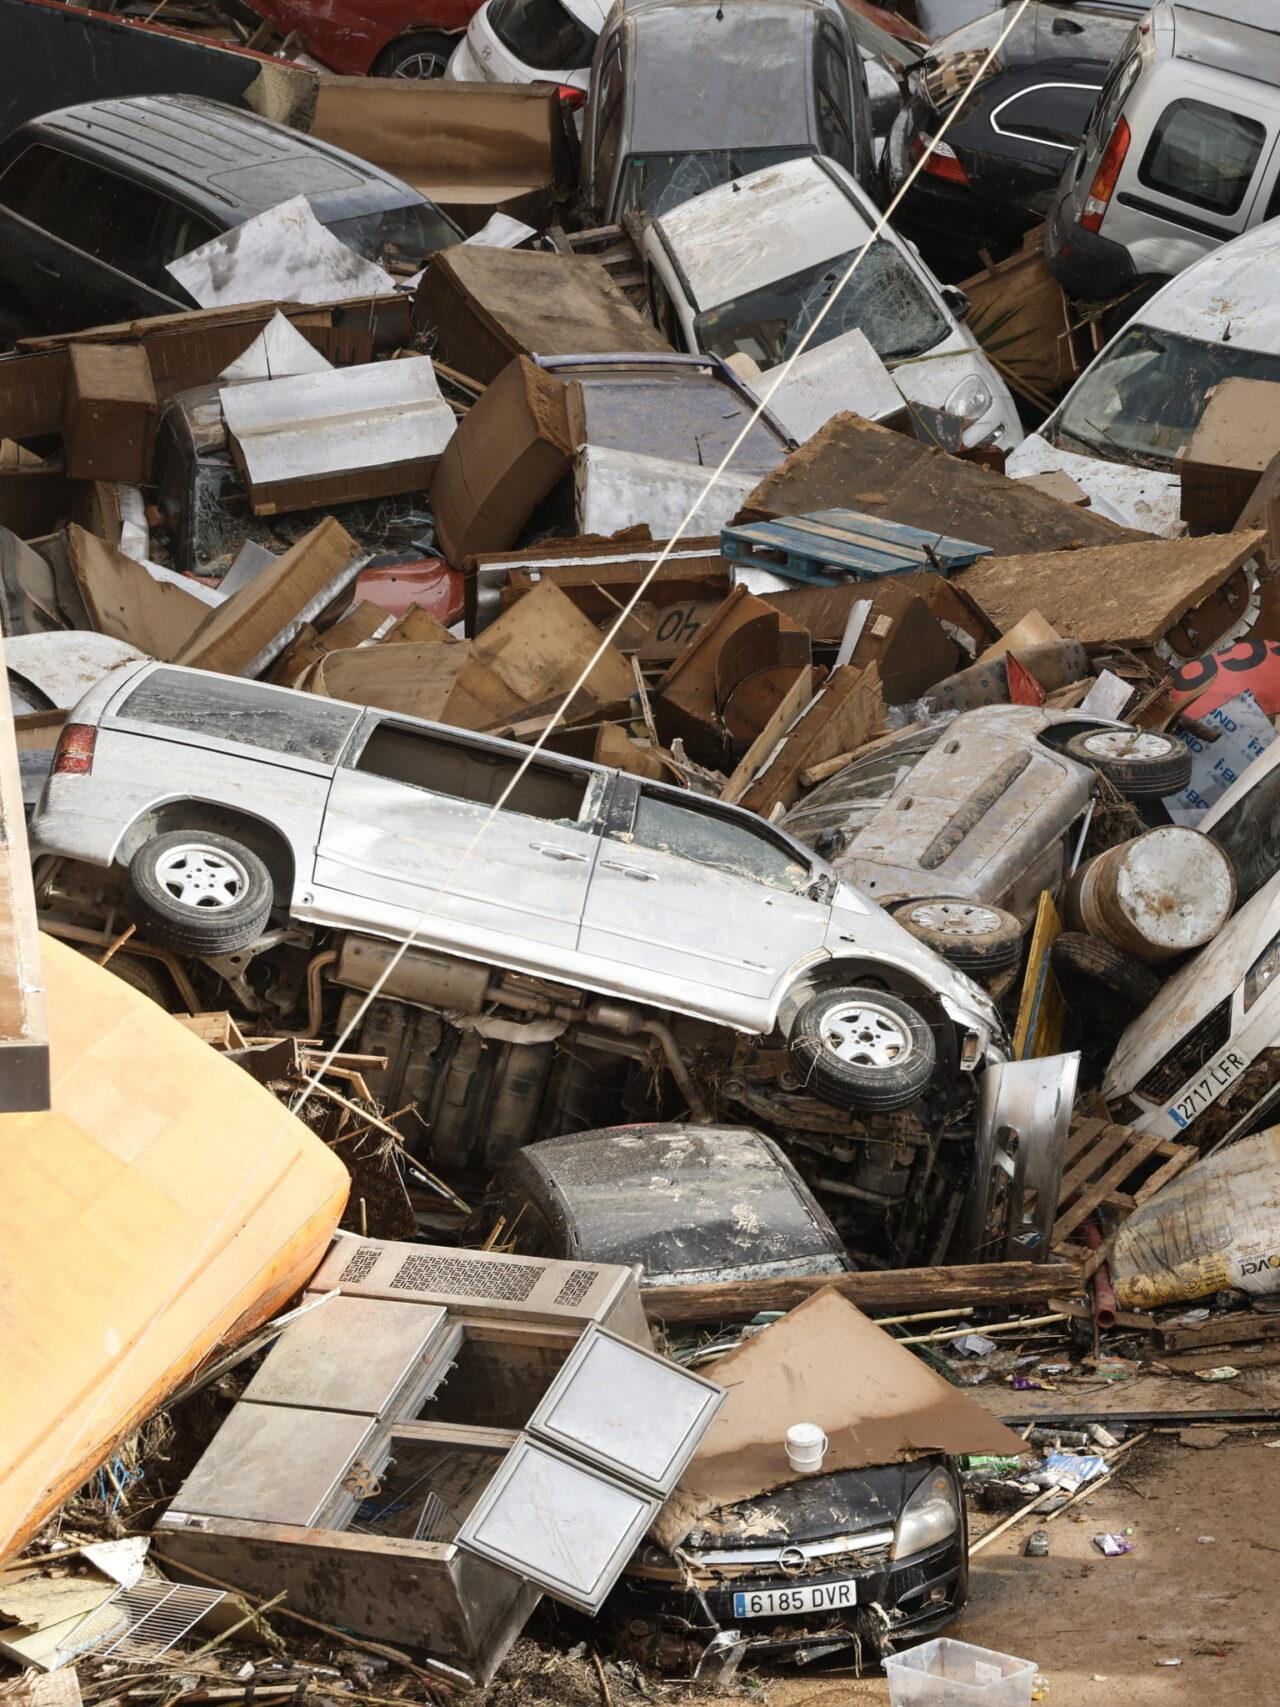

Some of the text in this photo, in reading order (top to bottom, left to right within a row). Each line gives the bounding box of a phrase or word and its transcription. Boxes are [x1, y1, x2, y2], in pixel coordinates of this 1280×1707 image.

[1177, 1053, 1244, 1120] 2717 LFR
[750, 1584, 851, 1614] 6185 DVR
